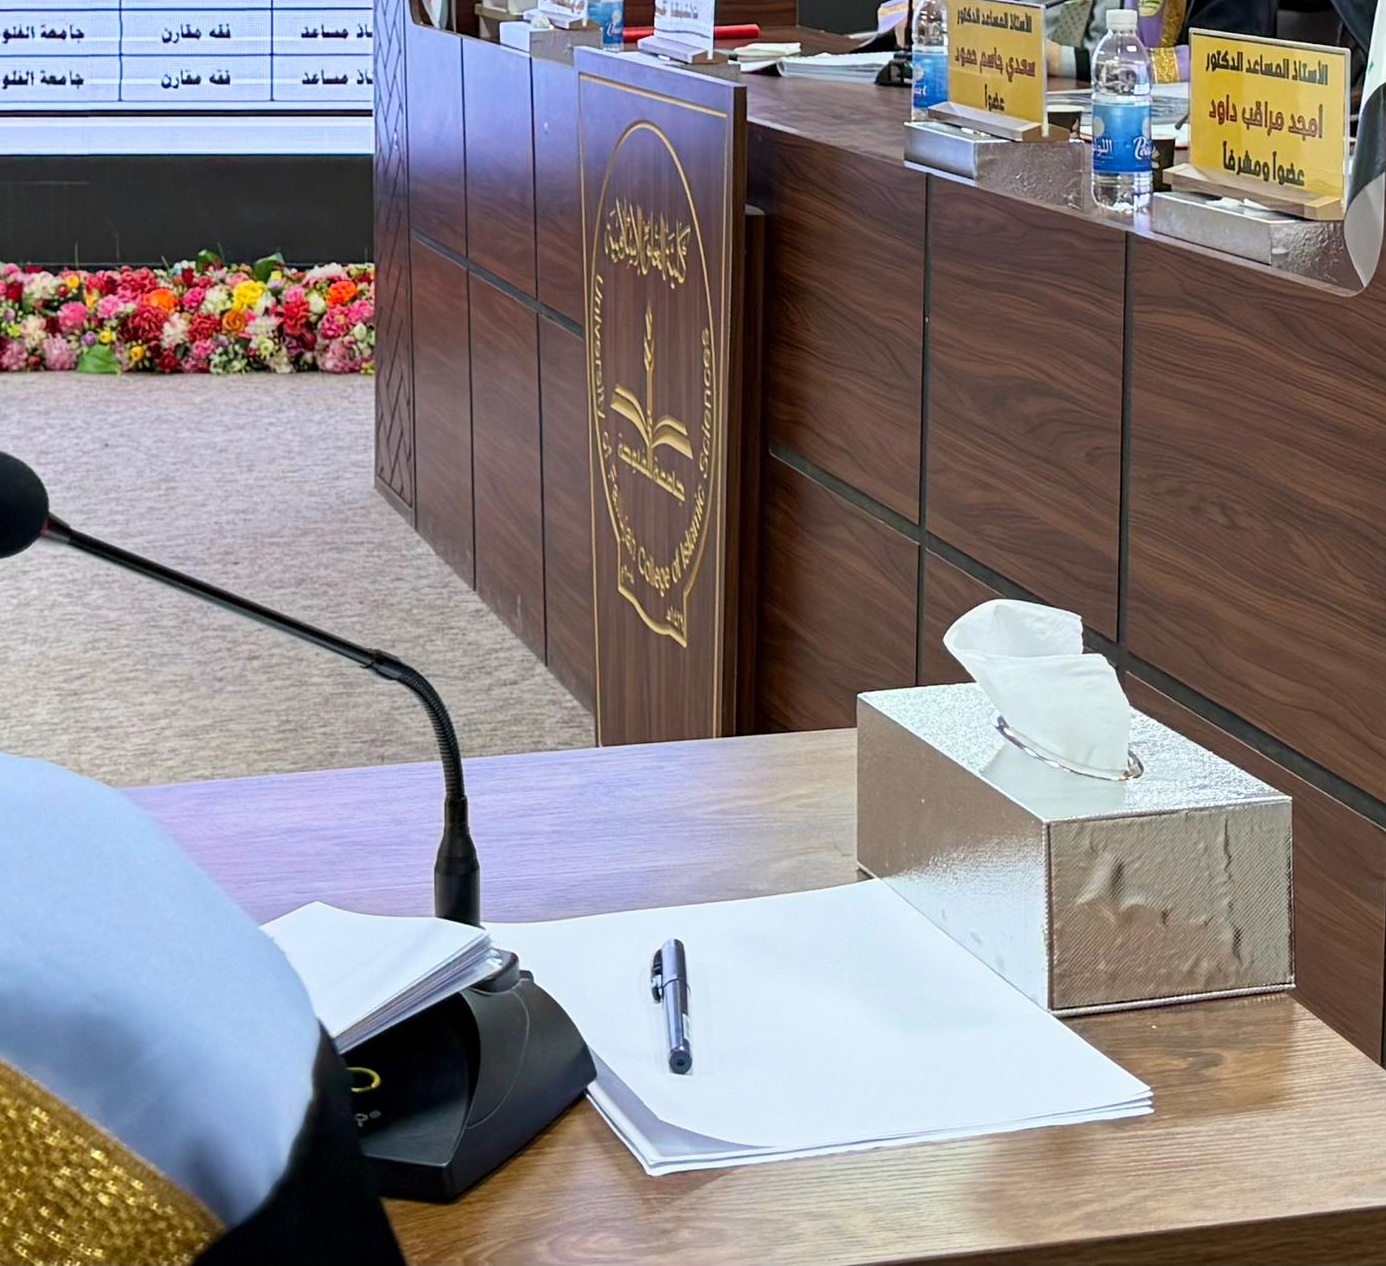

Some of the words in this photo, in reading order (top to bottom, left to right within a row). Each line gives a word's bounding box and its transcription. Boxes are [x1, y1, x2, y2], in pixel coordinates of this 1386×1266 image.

[1205, 49, 1243, 72] الدكتور
[1245, 54, 1289, 80] المساعد
[1209, 94, 1238, 125] داود
